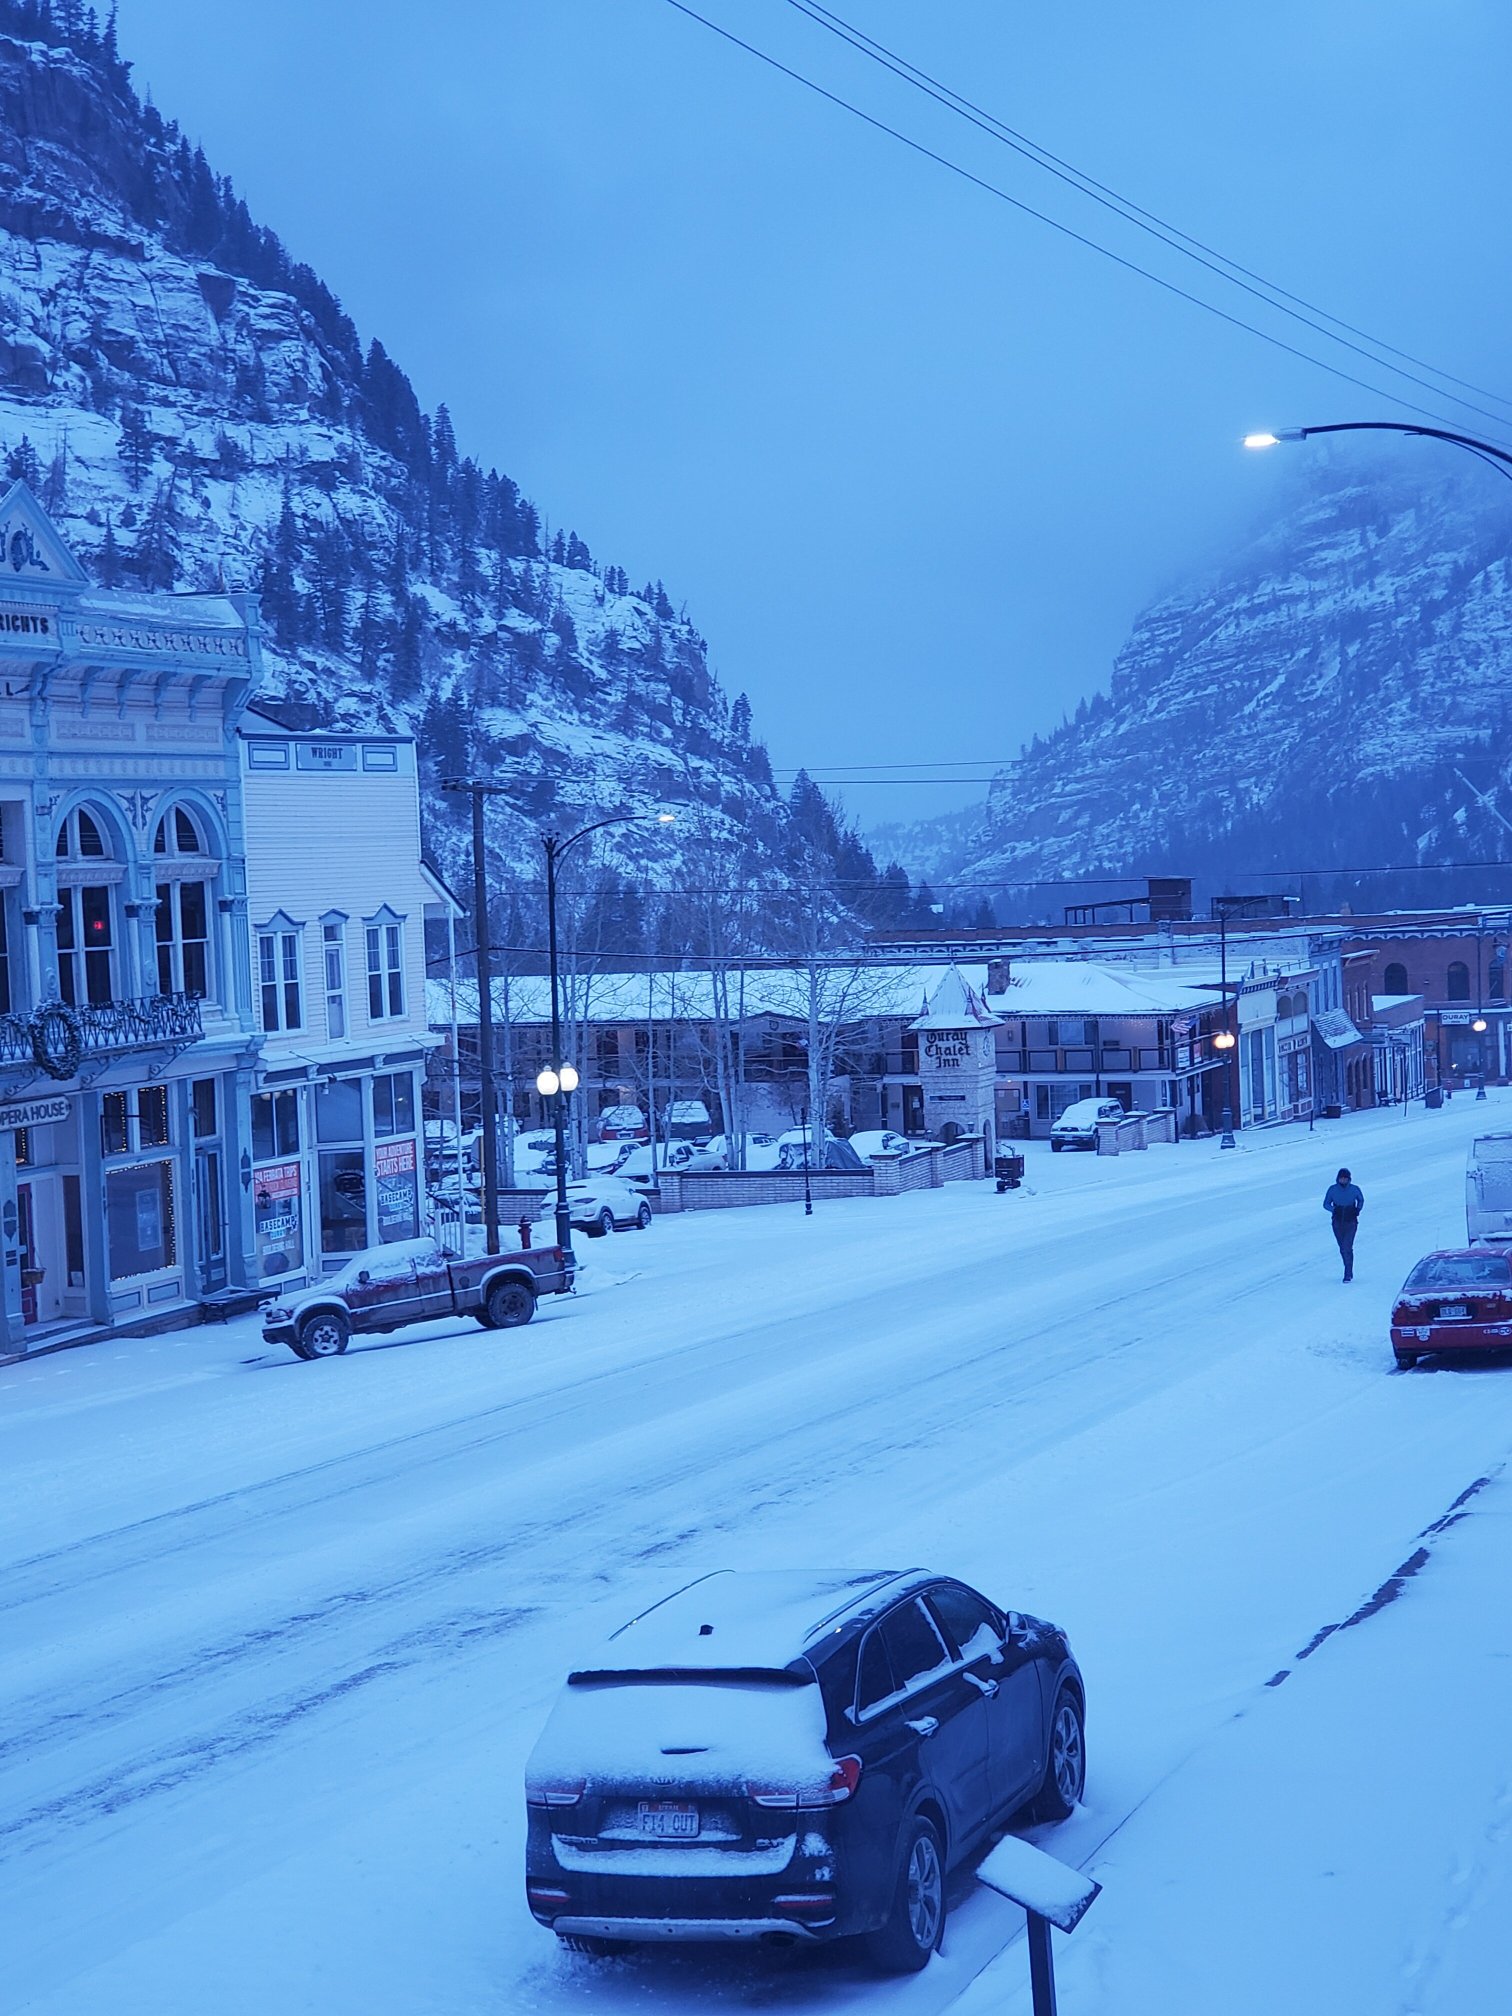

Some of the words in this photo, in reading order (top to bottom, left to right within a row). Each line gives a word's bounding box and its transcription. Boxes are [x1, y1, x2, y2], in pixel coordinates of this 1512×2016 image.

[311, 747, 343, 759] WRIGHT
[926, 1031, 968, 1045] Ouray
[925, 1044, 971, 1057] Chalet
[935, 1056, 960, 1068] Inn
[0, 1107, 29, 1126] PERA
[30, 1101, 65, 1121] HOUSE
[379, 1189, 412, 1205] BASECAMP
[259, 1215, 297, 1233] BASECAMP
